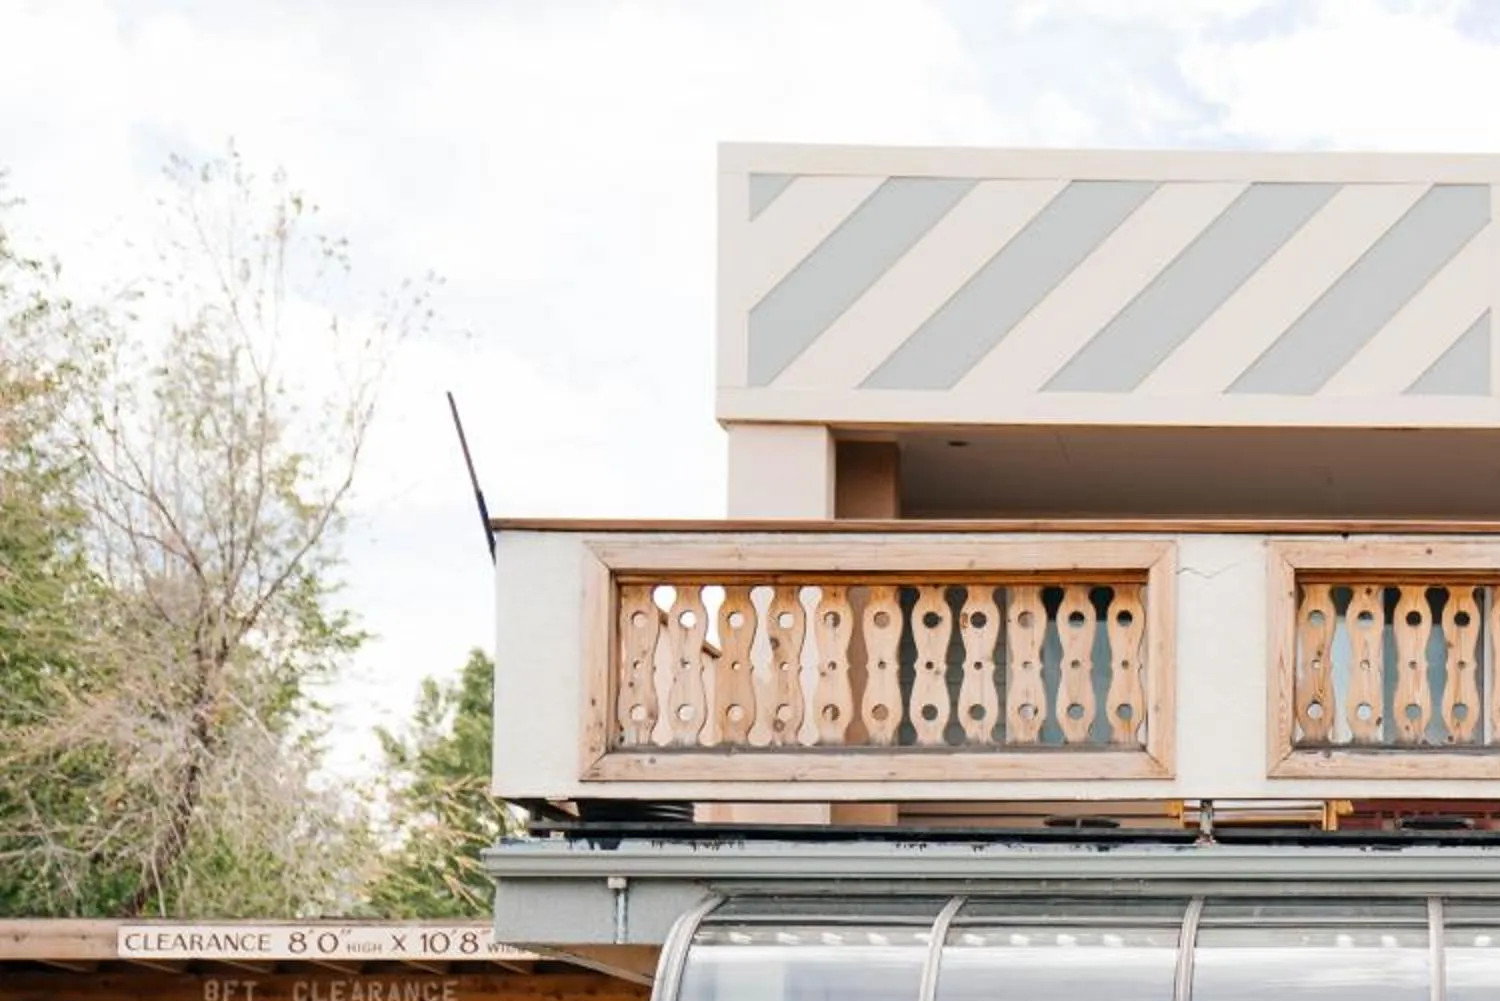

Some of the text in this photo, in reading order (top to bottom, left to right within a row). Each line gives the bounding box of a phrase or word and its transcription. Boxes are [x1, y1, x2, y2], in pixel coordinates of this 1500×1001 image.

[124, 932, 271, 952] CLEARANCE
[346, 943, 383, 953] HIGH
[391, 934, 408, 952] X
